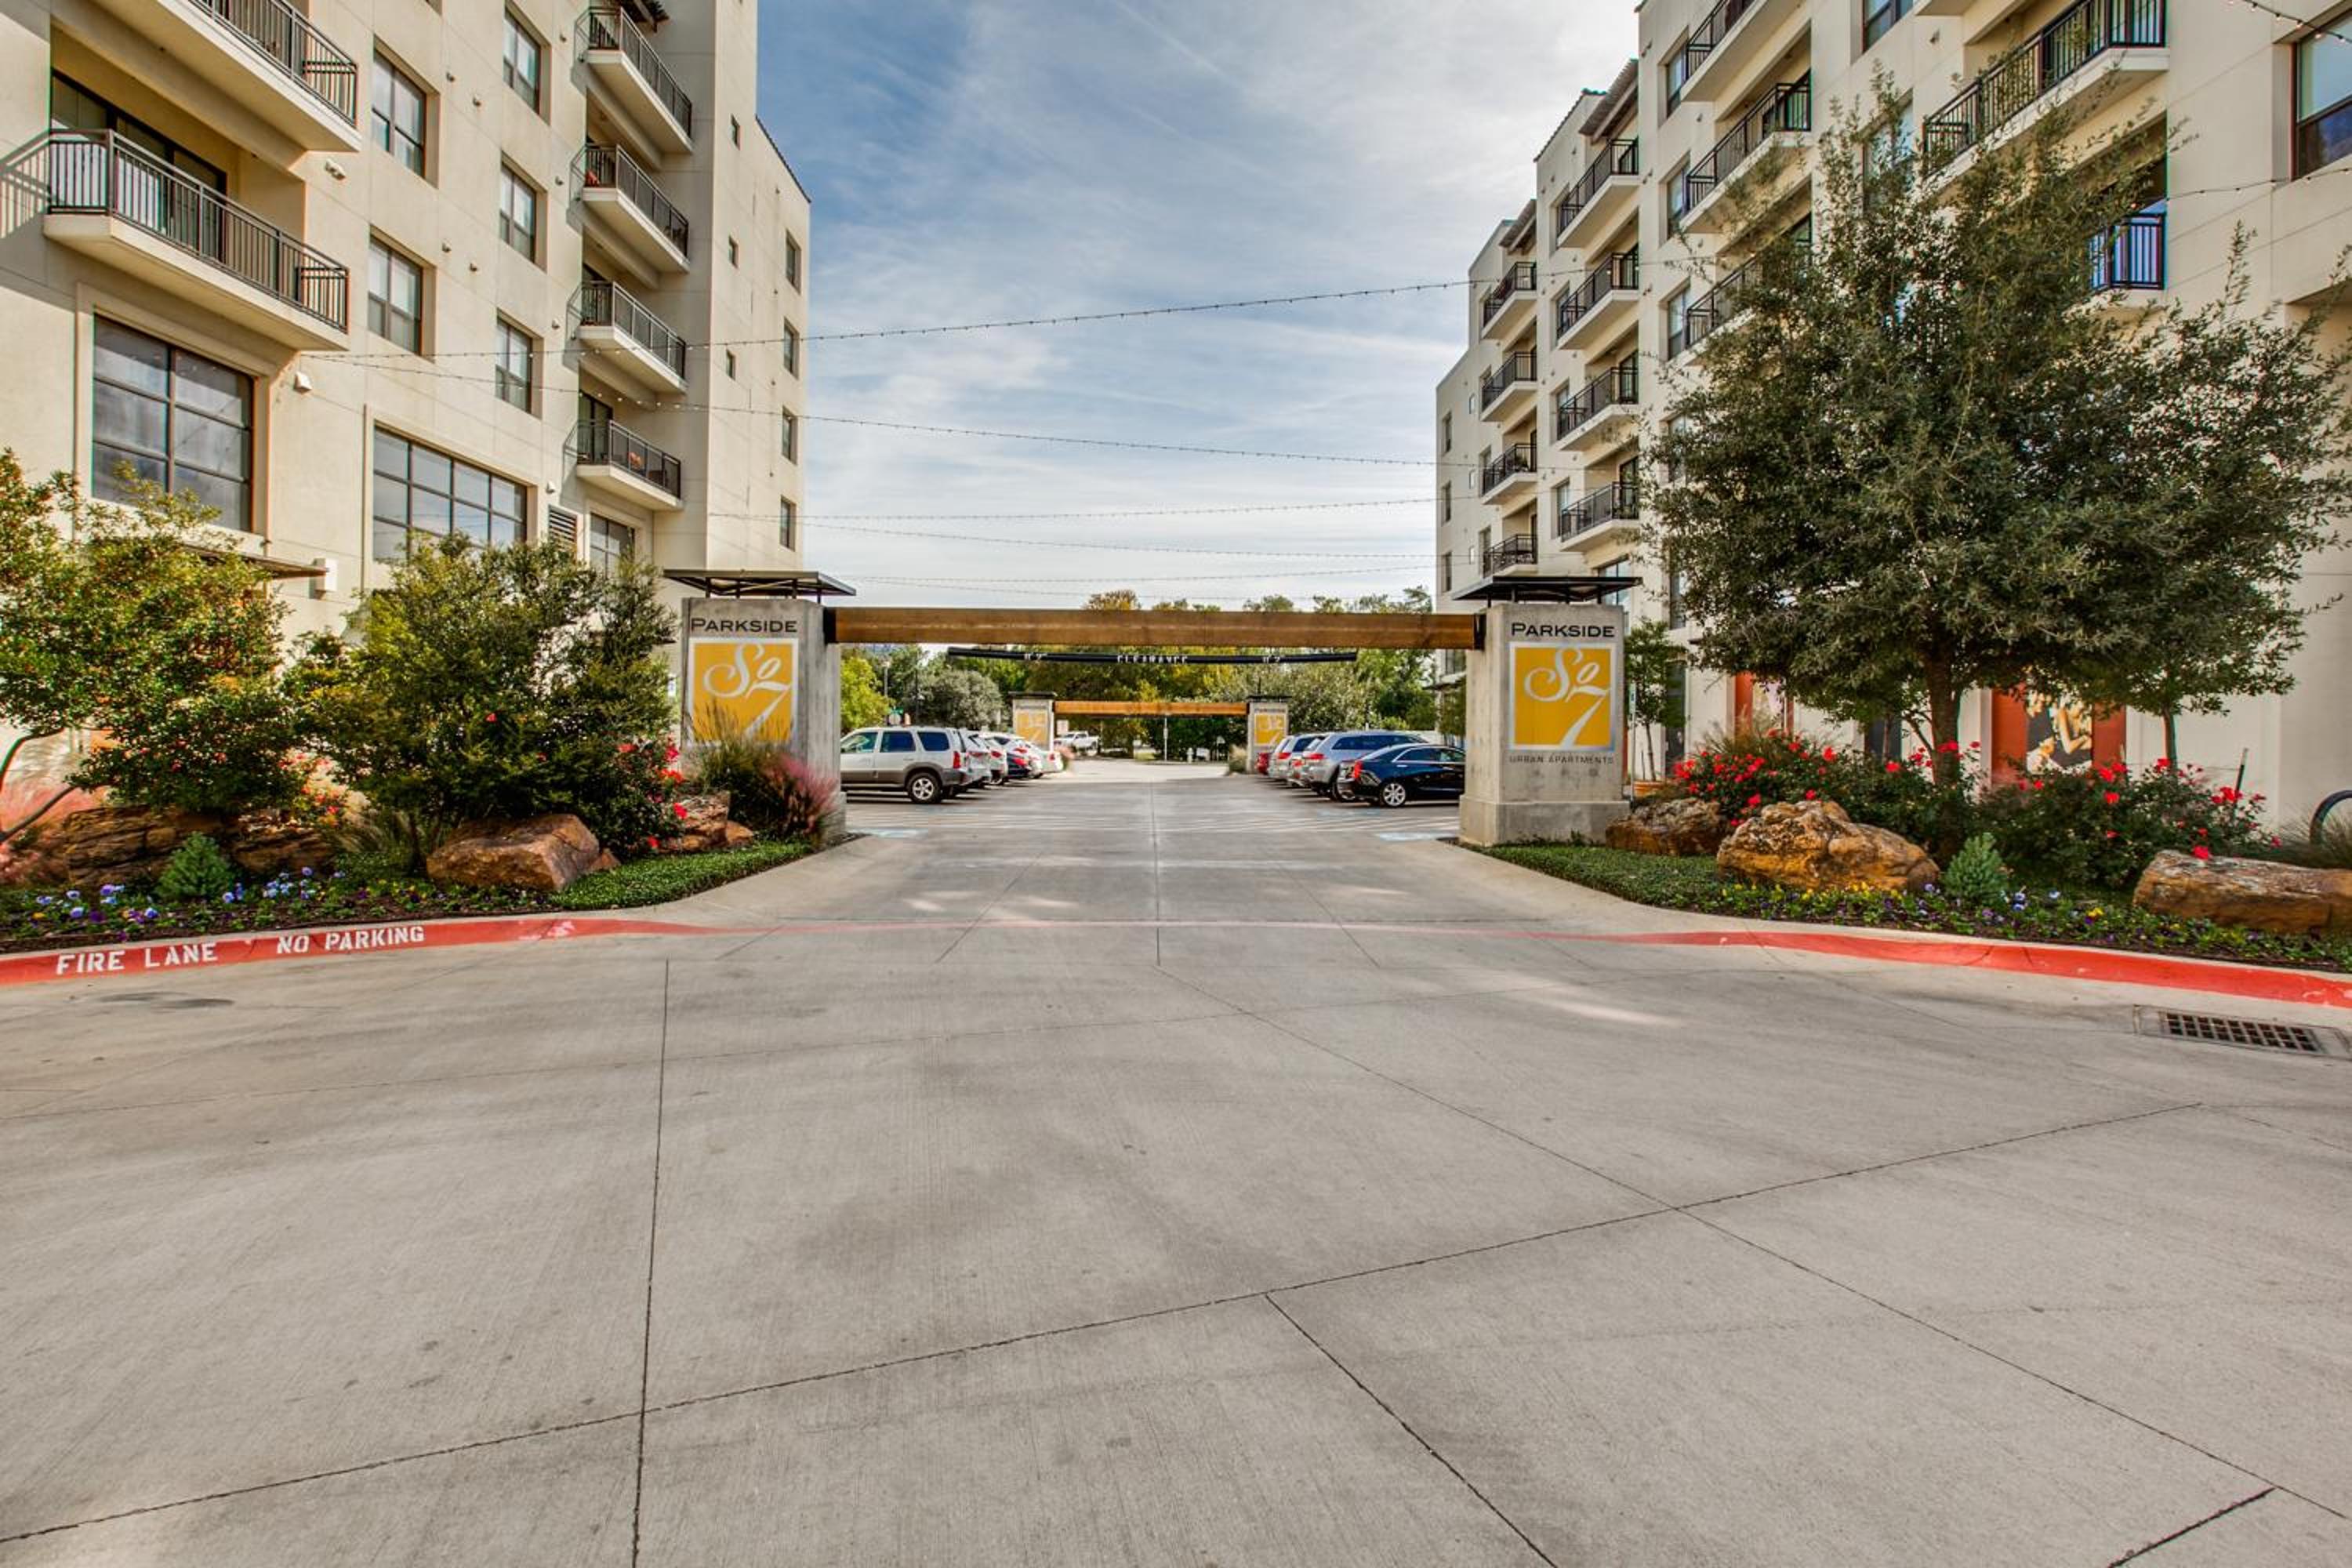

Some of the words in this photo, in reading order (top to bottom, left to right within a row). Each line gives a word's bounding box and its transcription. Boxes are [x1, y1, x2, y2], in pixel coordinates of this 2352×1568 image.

[691, 618, 797, 633] PARKSIDE
[1511, 622, 1615, 637] PARKSIDE
[1509, 755, 1544, 764] URBAN
[1548, 755, 1613, 764] APARTMENTS
[277, 934, 310, 954] NO
[325, 925, 425, 951] PARKING
[56, 949, 125, 975] FIRE
[144, 942, 219, 968] LANE
